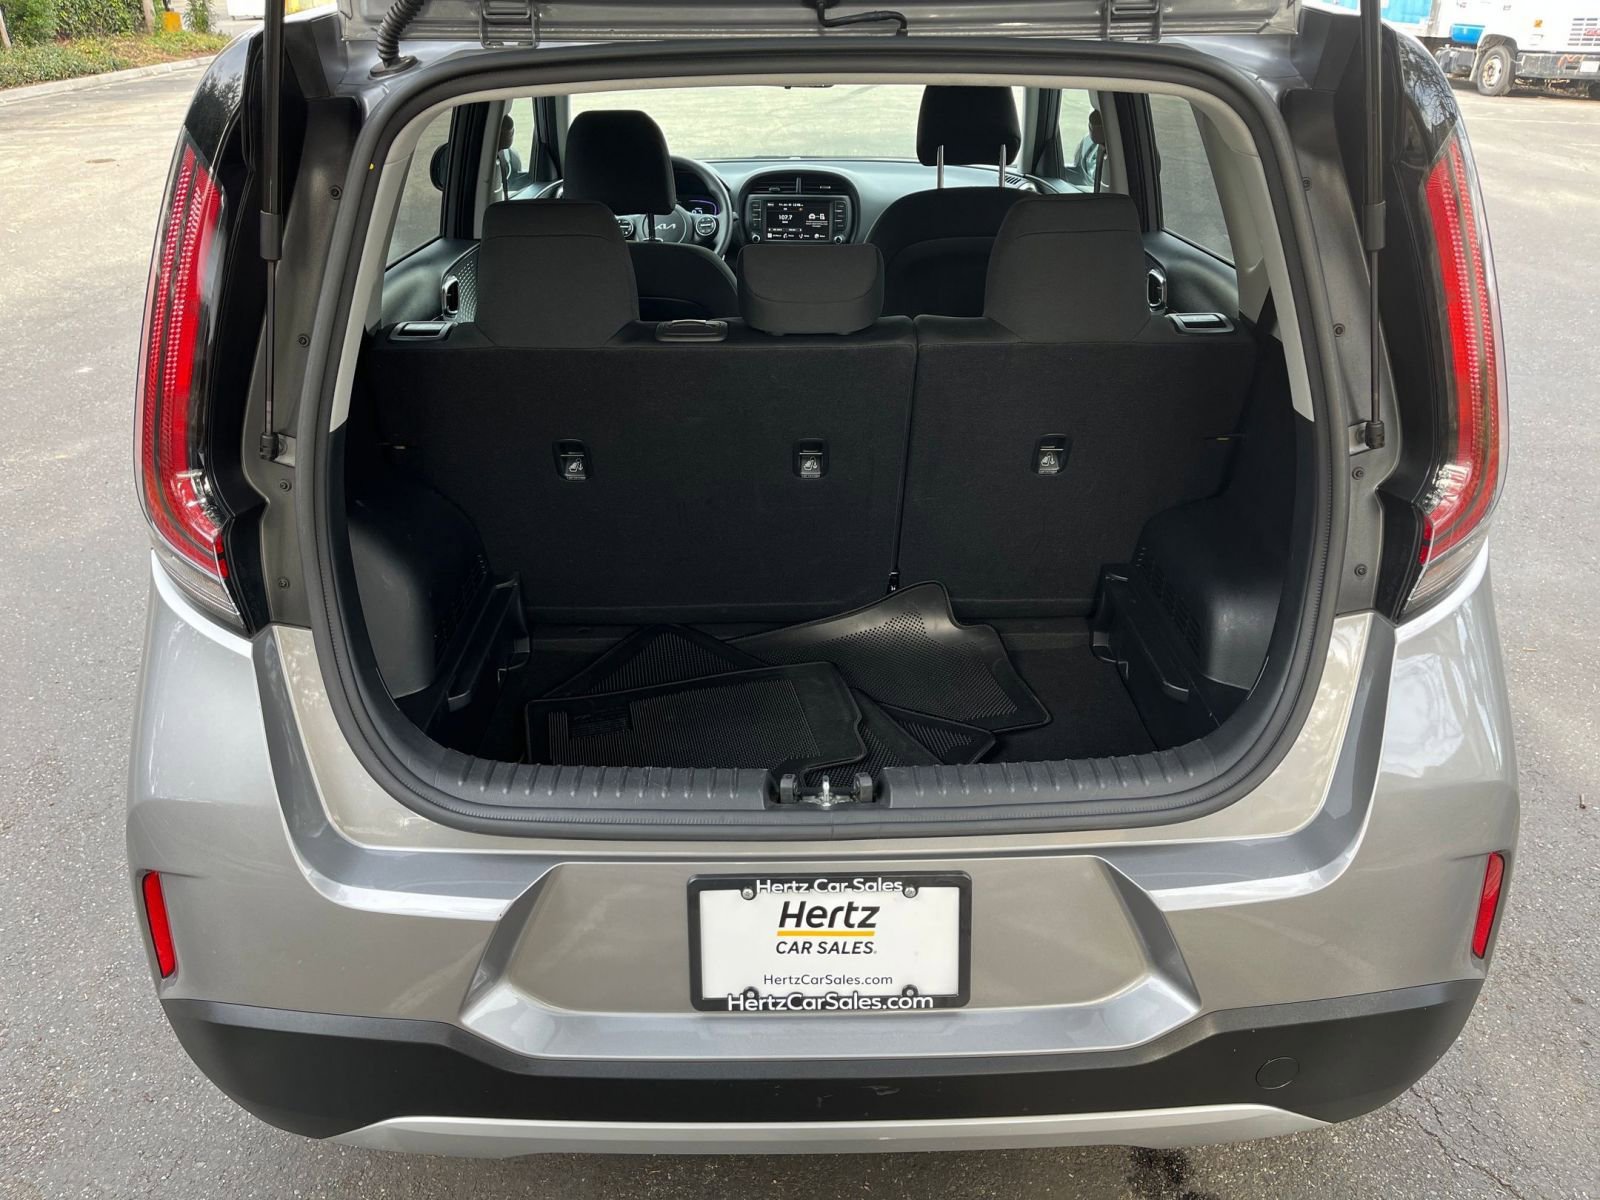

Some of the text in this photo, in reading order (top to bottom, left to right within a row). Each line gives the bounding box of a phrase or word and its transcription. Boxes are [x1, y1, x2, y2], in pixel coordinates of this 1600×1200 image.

[756, 877, 903, 894] Hertz Car Sales
[778, 901, 880, 929] Hertz
[776, 941, 812, 955] CAR
[764, 974, 893, 986] HertzCarSales.com
[727, 991, 934, 1011] HertzCarSales.com
